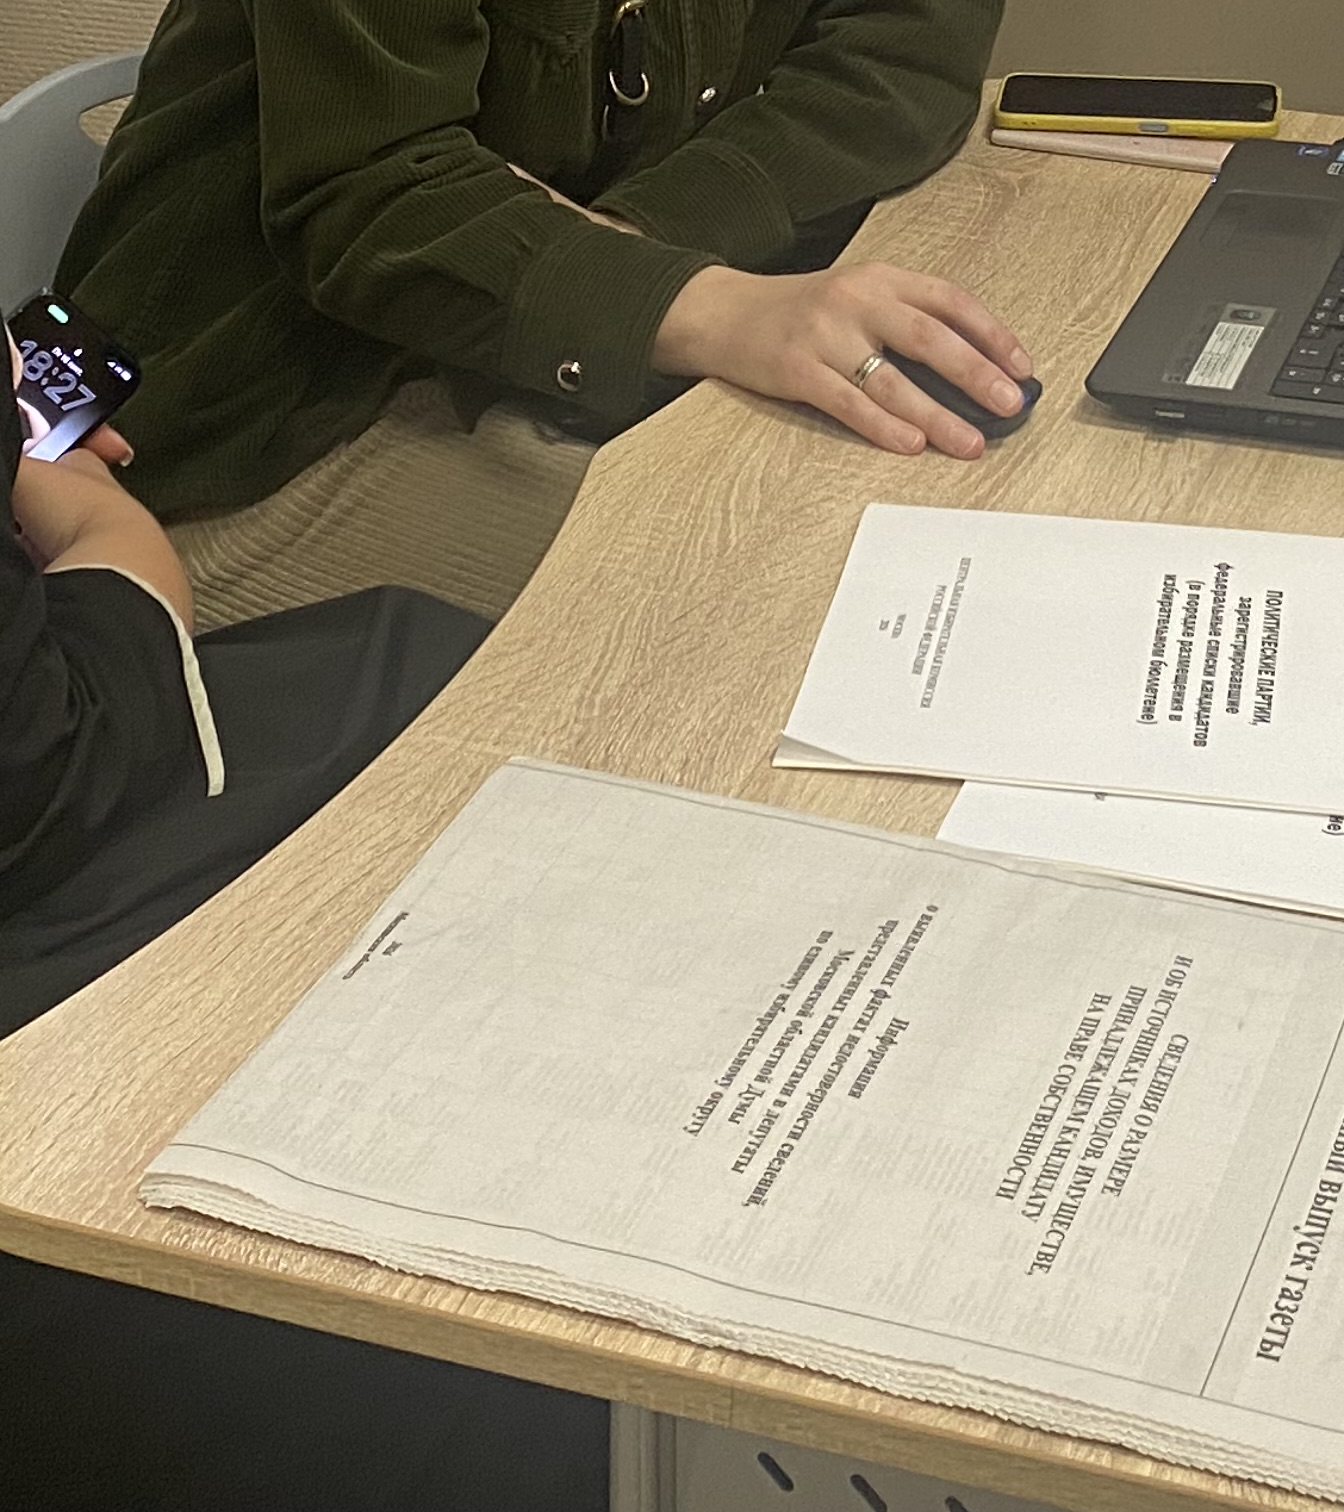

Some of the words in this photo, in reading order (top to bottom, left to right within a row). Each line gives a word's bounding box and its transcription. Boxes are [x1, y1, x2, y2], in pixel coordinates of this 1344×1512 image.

[19, 340, 97, 411] 18:27
[1151, 574, 1179, 657] избирательном
[1181, 593, 1199, 637] порядке
[1185, 580, 1205, 590] (в
[1208, 562, 1233, 636] федеральные
[1203, 639, 1219, 677] списки
[1225, 596, 1251, 714] зарегистрировавшие
[1257, 590, 1283, 676] ПОЛИТИЧЕСКИЕ
[1136, 659, 1167, 724] бюллетене)
[1170, 639, 1192, 711] размещения
[1251, 678, 1274, 725] ПАРТИИ,
[1192, 679, 1213, 747] кандидатов
[815, 930, 833, 943] по
[925, 904, 938, 912] о
[779, 945, 822, 990] единому
[795, 950, 855, 1017] Московской
[831, 920, 898, 1011] представленных
[879, 913, 932, 987] выявленных
[1164, 968, 1186, 988] ОБ
[1174, 955, 1193, 967] И
[852, 988, 891, 1032] фактах
[1086, 993, 1111, 1013] НА
[713, 993, 790, 1087] избирательному
[753, 1019, 803, 1083] областной
[779, 1014, 838, 1097] кандидатами
[847, 1017, 909, 1098] Информация
[1063, 1016, 1100, 1061] ПРАВЕ
[1065, 985, 1147, 1123] ПРИНАДЛЕЖАЩЕМ
[1117, 989, 1177, 1086] ИСТОЧНИКАХ
[727, 1083, 765, 1124] Думы
[772, 1098, 786, 1108] в
[786, 1033, 860, 1140] недостоверности
[1139, 1034, 1188, 1113] СВЕДЕНИЯ
[682, 1091, 723, 1136] округу
[730, 1108, 779, 1173] депутаты
[994, 1064, 1076, 1199] СОБСТВЕННОСТИ
[1080, 1086, 1130, 1160] ДОХОДОВ,
[1133, 1114, 1152, 1127] О
[741, 1142, 794, 1206] сведений,
[1020, 1125, 1080, 1218] КАНДИДАТУ
[1100, 1128, 1147, 1196] РАЗМЕРЕ
[1025, 1164, 1095, 1275] ИМУЩЕСТВЕ,
[1289, 1179, 1342, 1271] выпуск
[1255, 1274, 1307, 1362] газеты
